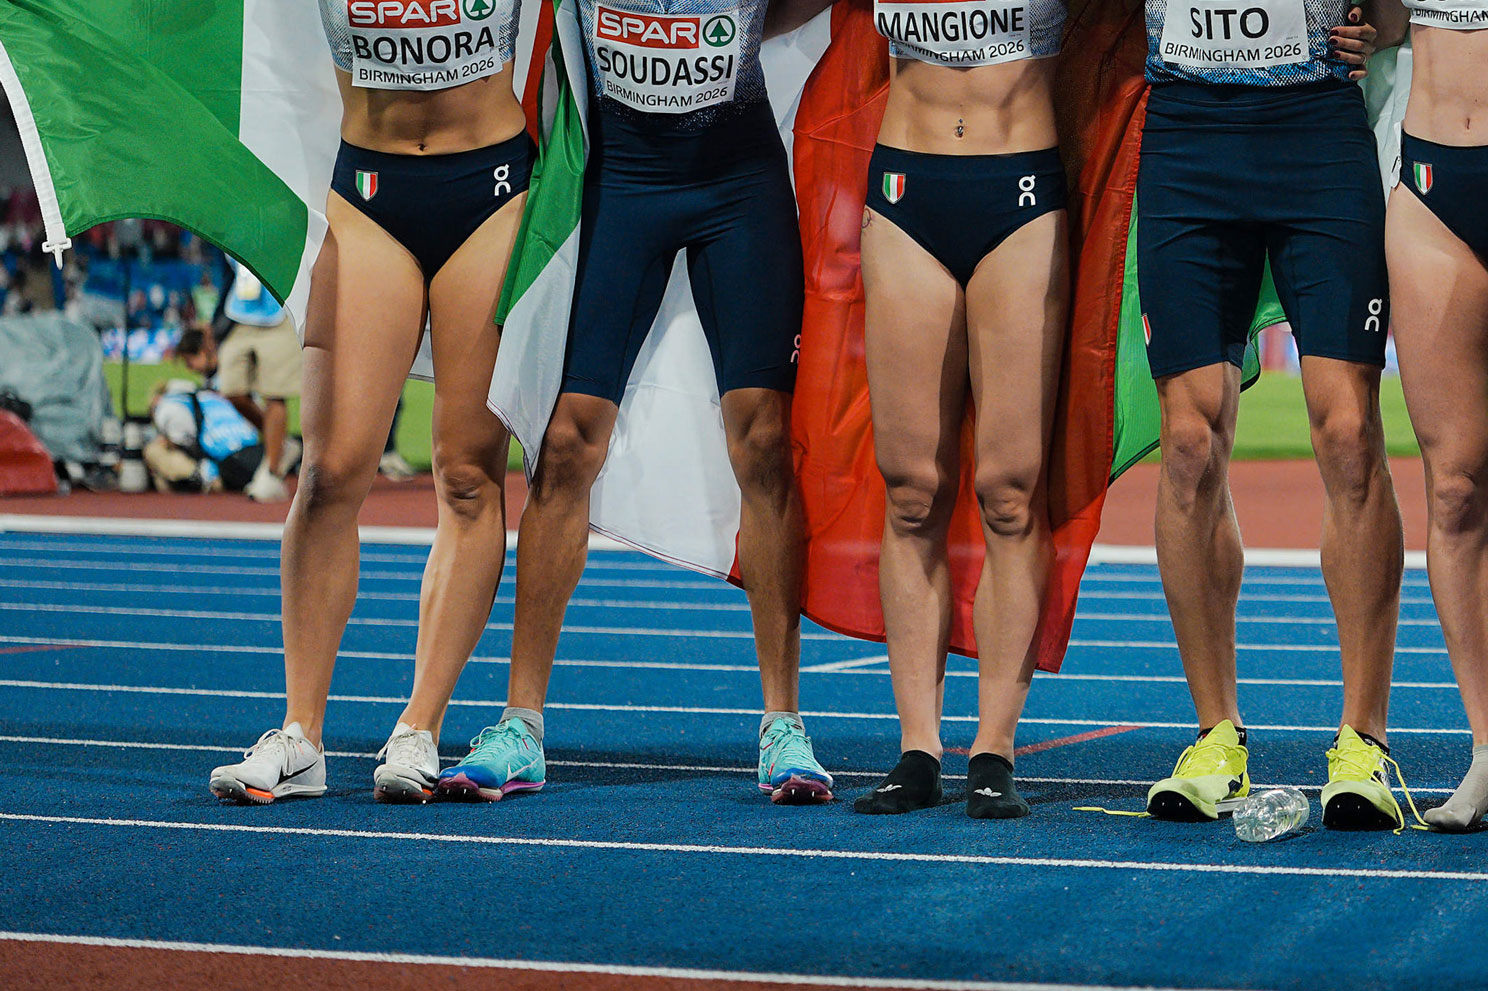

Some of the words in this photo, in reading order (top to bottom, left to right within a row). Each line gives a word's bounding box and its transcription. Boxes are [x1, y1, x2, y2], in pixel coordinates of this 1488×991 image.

[350, 0, 458, 24] SPAR
[878, 7, 1024, 42] MANGIONE
[1190, 7, 1269, 40] SITO
[600, 11, 697, 45] SPAR
[352, 26, 495, 65] BONORA
[988, 40, 1024, 58] 2026
[1164, 42, 1260, 62] BIRMINGHAM
[1265, 43, 1301, 60] 2026
[359, 68, 458, 85] BIRMINGHAM
[462, 57, 494, 77] 2026
[597, 46, 734, 87] SOUDASSI
[606, 80, 692, 107] BIRMINGHAM
[695, 87, 728, 104] 2026
